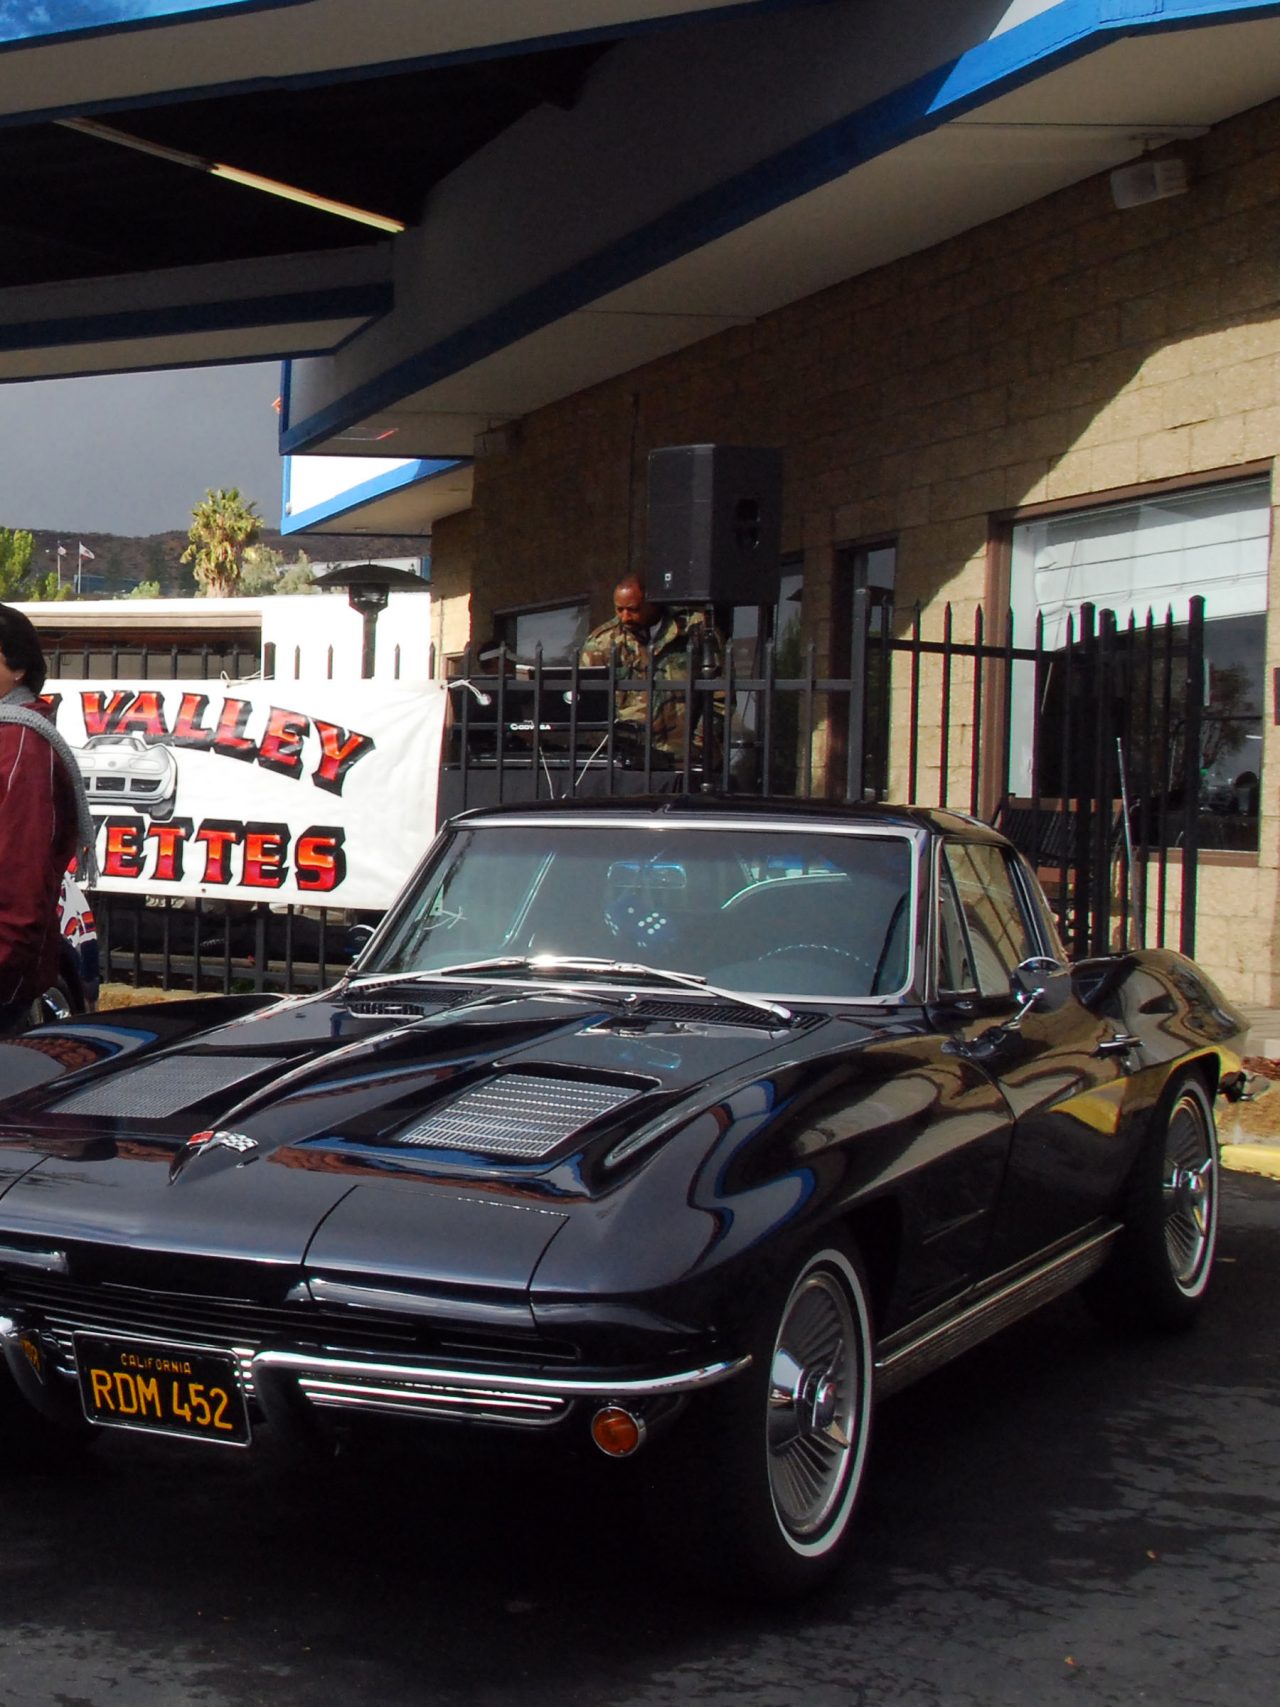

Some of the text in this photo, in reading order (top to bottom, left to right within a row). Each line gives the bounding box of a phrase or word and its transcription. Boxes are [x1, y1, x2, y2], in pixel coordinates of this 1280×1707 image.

[80, 689, 376, 797] VALLEY
[92, 816, 346, 893] ETTES
[120, 1353, 192, 1375] CALIFORNIA
[90, 1368, 234, 1430] RDM 452
